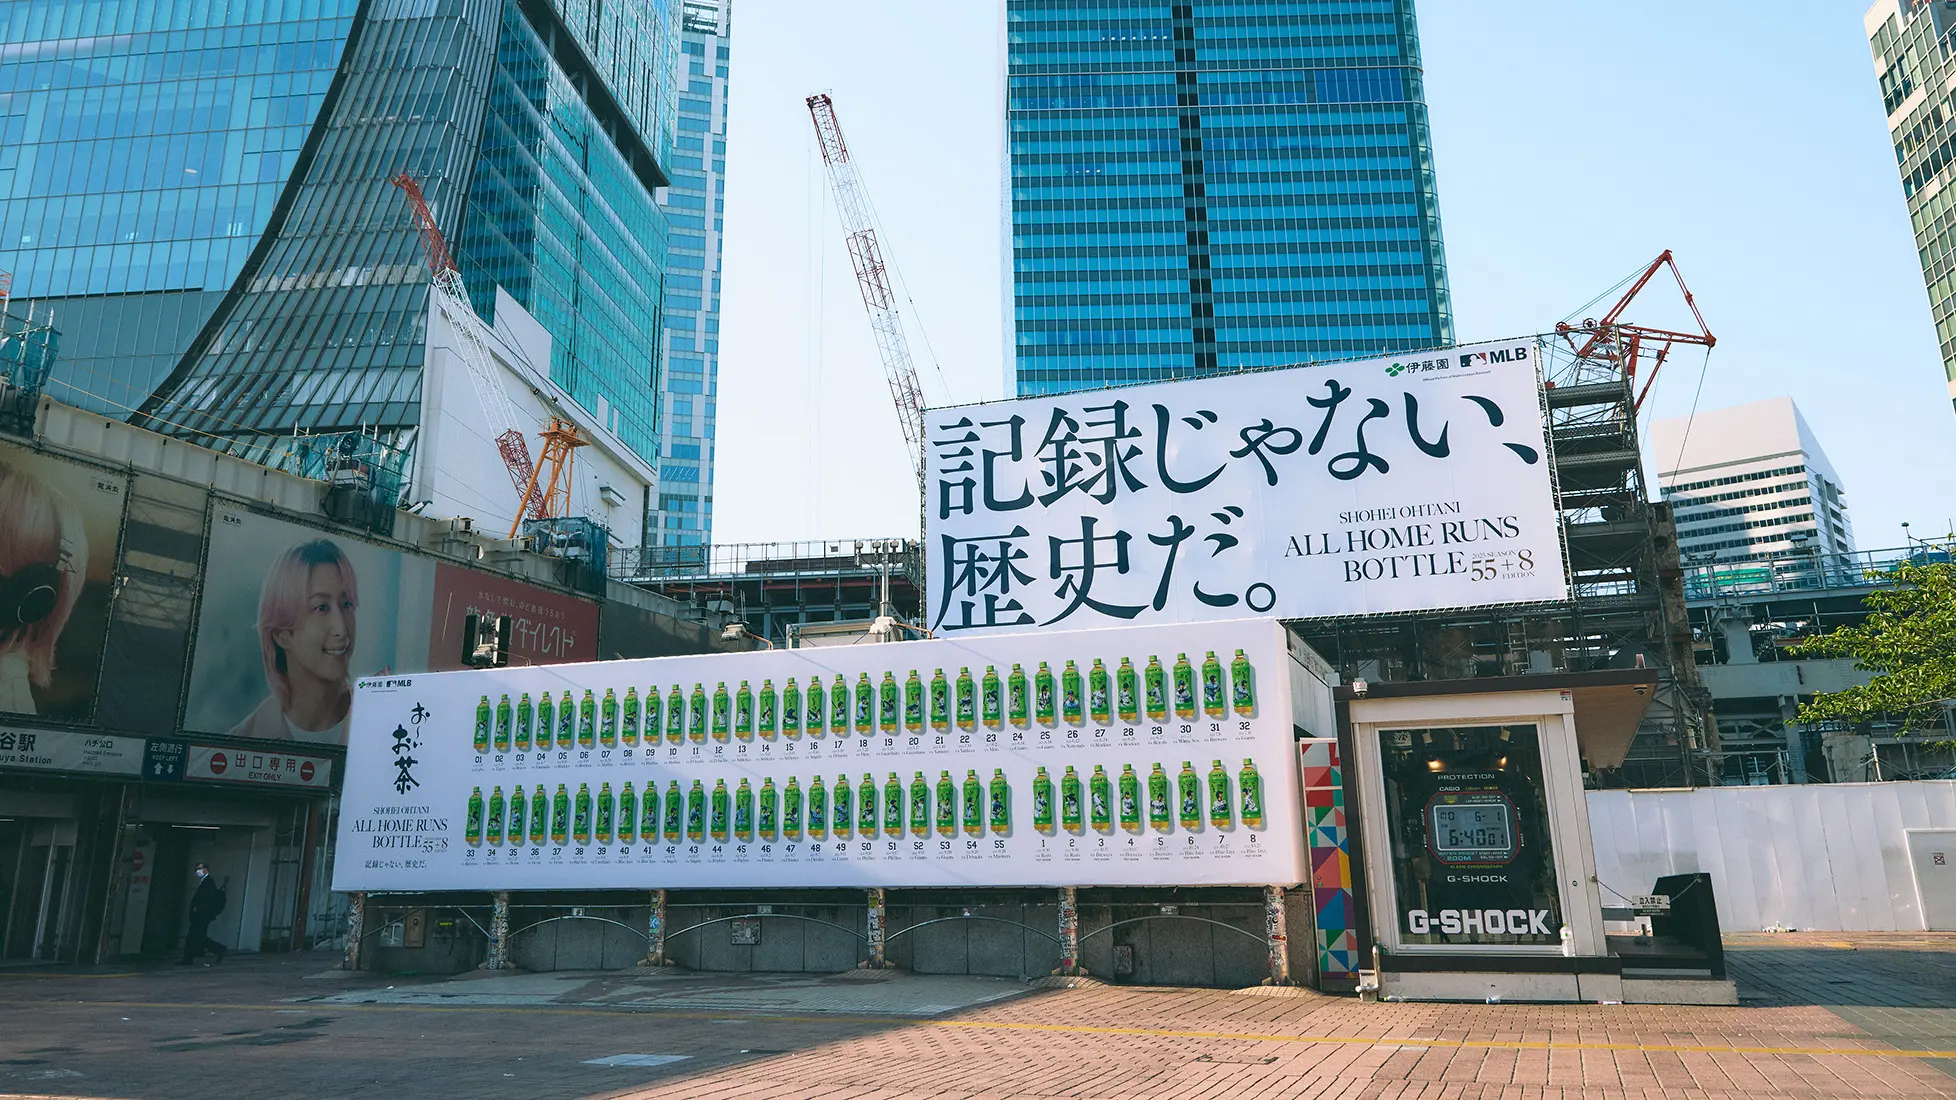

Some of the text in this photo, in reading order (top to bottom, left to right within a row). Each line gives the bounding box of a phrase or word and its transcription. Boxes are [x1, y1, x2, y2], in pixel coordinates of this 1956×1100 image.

[1490, 347, 1527, 364] MLB
[1406, 358, 1449, 374] 伊藤園
[932, 379, 1540, 520] 記録じゃない、
[1339, 501, 1461, 524] SHOHEI OHTANI
[1284, 515, 1520, 558] ALL HOME RUNS
[1486, 550, 1517, 559] SEASON
[933, 506, 1277, 633] 歴史だ。
[1343, 551, 1468, 583] BOTTLE
[1502, 571, 1535, 580] EDITION
[397, 679, 412, 687] MLB
[1180, 725, 1191, 733] 30
[1210, 723, 1219, 731] 31
[1239, 722, 1250, 730] 32
[1067, 730, 1078, 738] 26
[1095, 729, 1105, 737] 27
[1123, 728, 1134, 736] 28
[1152, 726, 1162, 735] 29
[960, 735, 969, 743] 22
[986, 734, 996, 742] 23
[1013, 733, 1023, 741] 24
[1040, 731, 1050, 739] 25
[0, 732, 36, 752] 谷駅
[85, 740, 113, 748] ハチ公口
[860, 739, 867, 747] 18
[885, 738, 892, 746] 19
[909, 737, 918, 745] 20
[936, 736, 943, 744] 21
[150, 742, 183, 754] 左側通行
[716, 746, 723, 754] 12
[739, 745, 746, 753] 13
[786, 743, 793, 751] 15
[810, 742, 818, 750] 16
[20, 754, 52, 765] Station
[235, 752, 297, 773] 出口専用
[249, 772, 282, 782] EXIT ONLY
[373, 806, 430, 815] SHOHEI OHTANI
[351, 818, 448, 832] ALL HOME RUNS
[372, 835, 422, 848] BOTTLE
[940, 841, 950, 849] 53
[967, 841, 977, 849] 54
[995, 840, 1004, 848] 55
[666, 846, 675, 854] 42
[737, 845, 746, 853] 45
[811, 844, 820, 852] 48
[836, 843, 846, 851] 49
[888, 842, 896, 850] 51
[914, 842, 923, 850] 52
[531, 848, 539, 856] 36
[598, 847, 606, 855] 39
[1447, 875, 1508, 883] G-SHOCK
[1408, 909, 1551, 935] G-SHOCK
